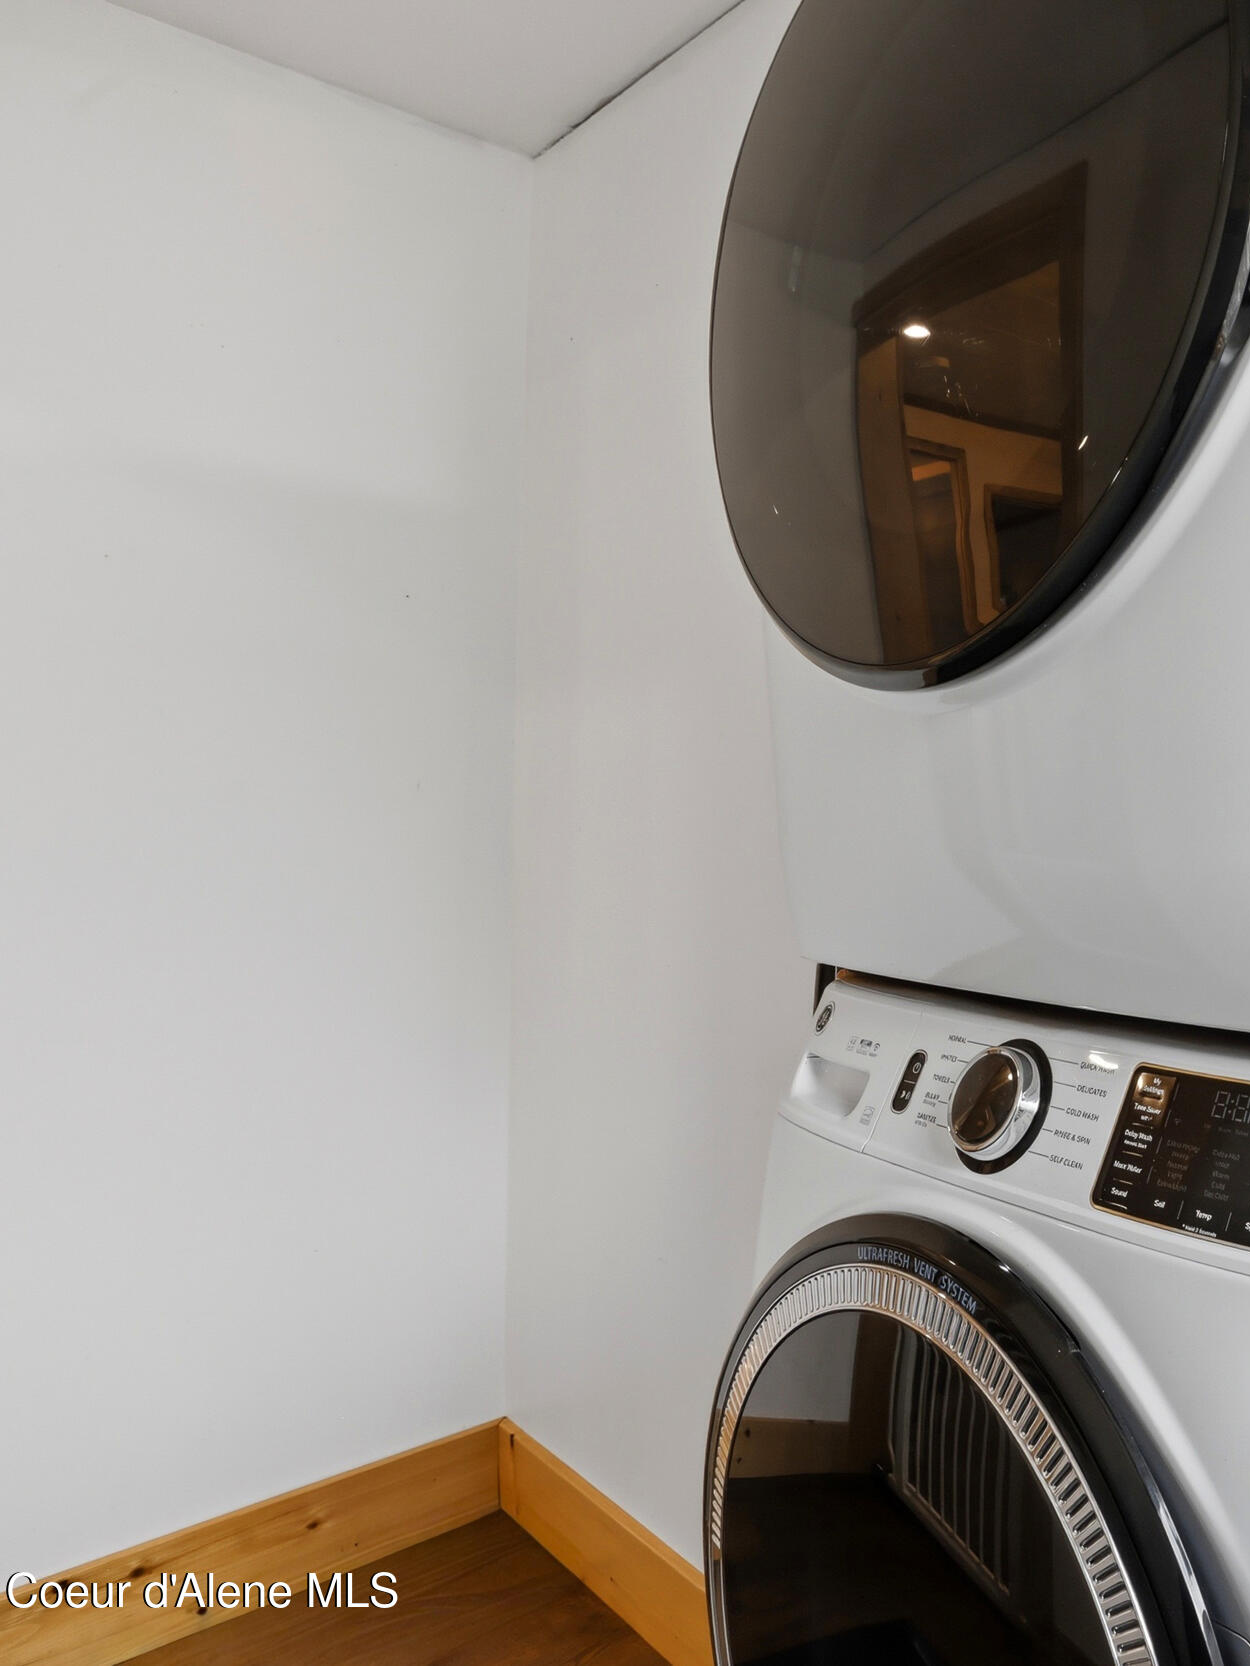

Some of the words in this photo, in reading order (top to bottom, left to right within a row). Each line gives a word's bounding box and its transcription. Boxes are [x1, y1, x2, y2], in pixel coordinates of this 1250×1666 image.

[1076, 1084, 1108, 1098] DELICATES
[1065, 1107, 1082, 1118] COLD
[1082, 1111, 1100, 1122] WASH
[1053, 1129, 1071, 1141] RINSE
[1076, 1135, 1091, 1145] SPIN
[1124, 1128, 1139, 1139] Delay
[1138, 1131, 1153, 1142] Wash
[1049, 1154, 1064, 1164] SELF
[1064, 1158, 1083, 1170] CLEAN
[1110, 1186, 1129, 1198] Sound
[1153, 1199, 1166, 1209] Soil
[1195, 1209, 1212, 1222] Temp
[857, 1245, 911, 1270] ULTRAFRESH
[913, 1256, 939, 1283] VENT
[939, 1274, 978, 1315] SYSTEM
